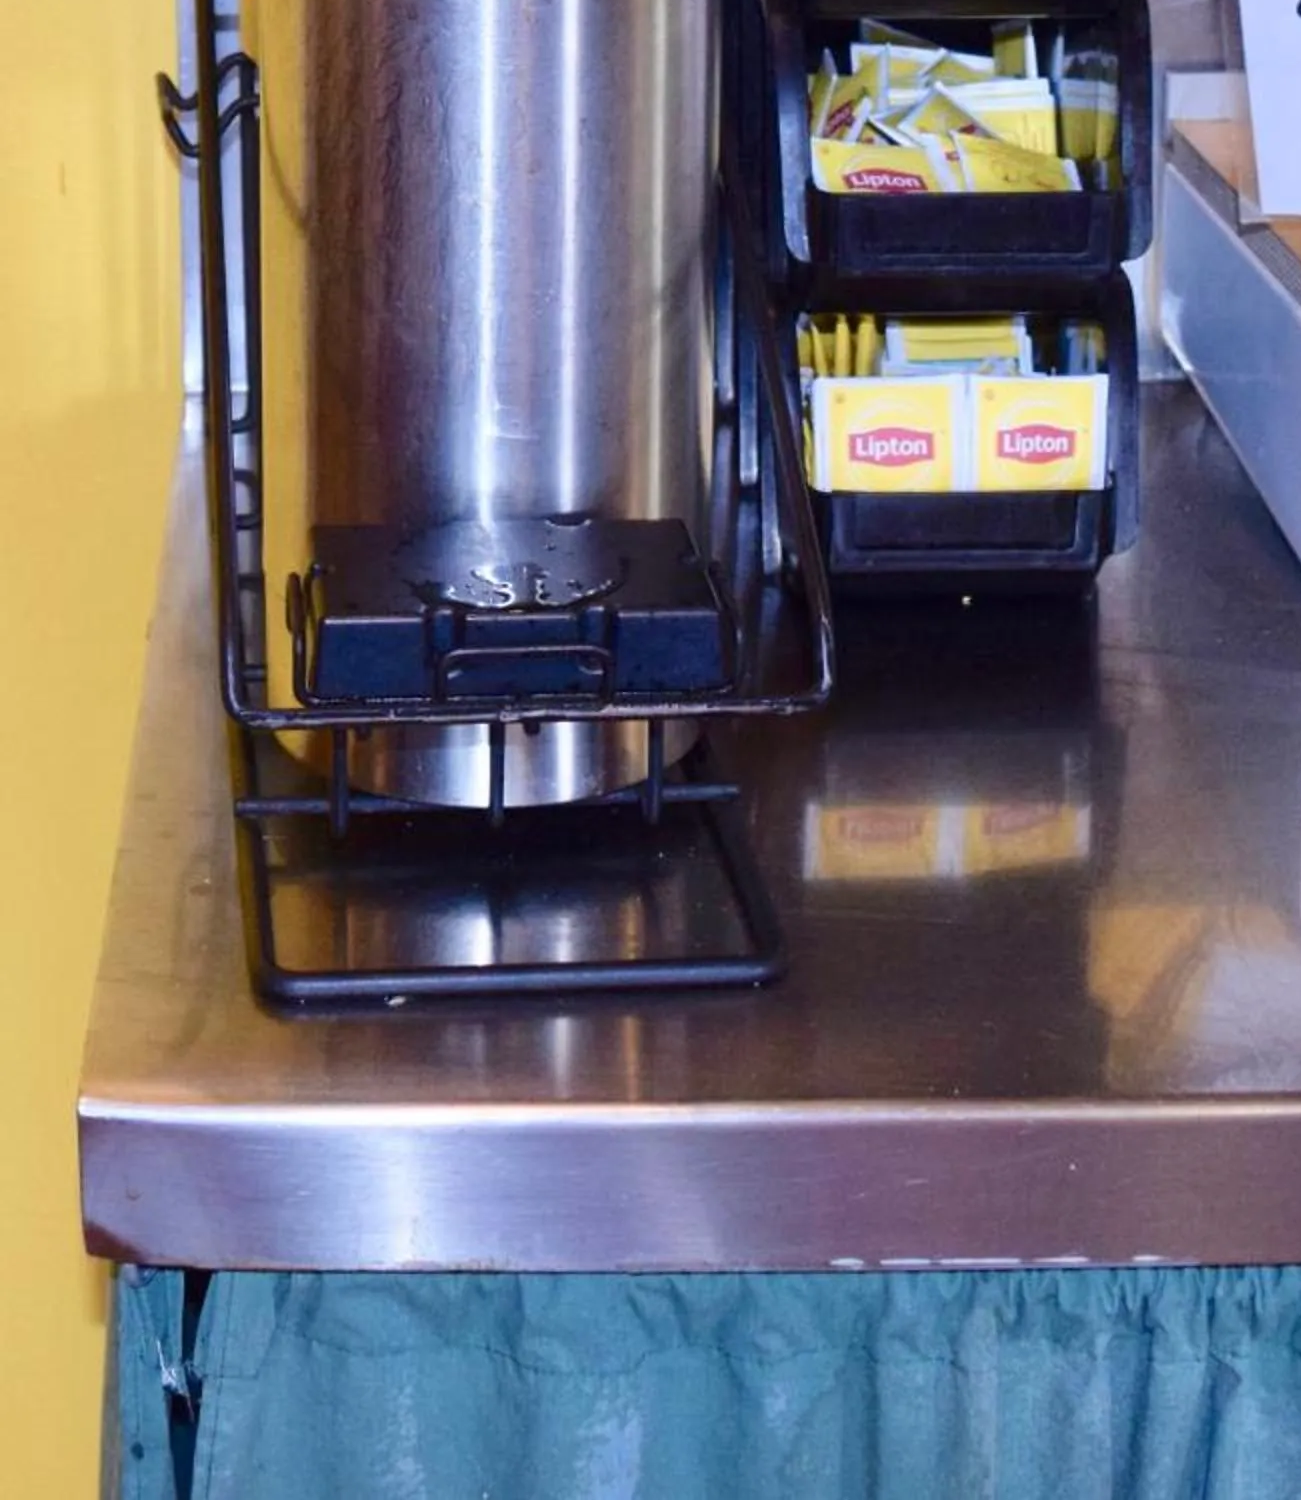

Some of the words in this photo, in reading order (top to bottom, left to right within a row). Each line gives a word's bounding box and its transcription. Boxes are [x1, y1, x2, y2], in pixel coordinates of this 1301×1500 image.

[849, 170, 921, 192] Lipton
[855, 436, 928, 461] Lipton
[1003, 432, 1069, 458] Lipton
